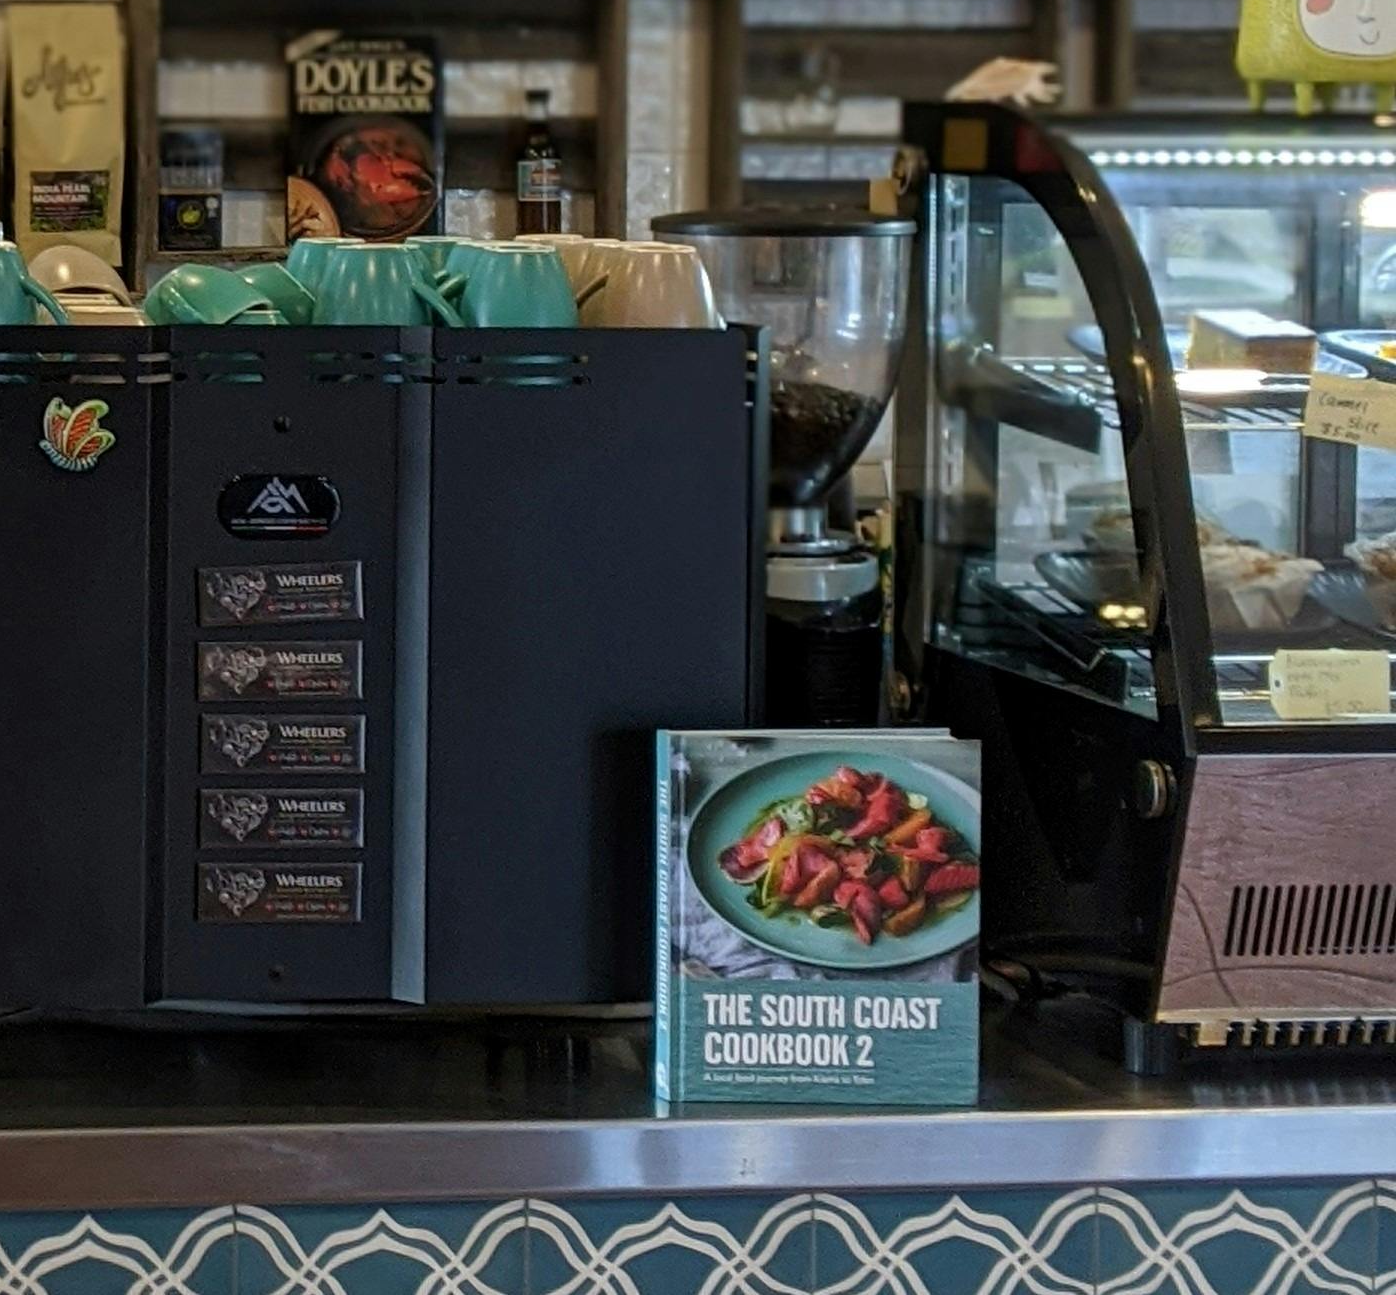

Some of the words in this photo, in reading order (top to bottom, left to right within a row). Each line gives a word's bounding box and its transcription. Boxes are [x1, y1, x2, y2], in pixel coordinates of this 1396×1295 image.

[275, 573, 344, 588] WHEELERS
[275, 651, 344, 665] WHEELERS
[278, 724, 347, 739] WHEELERS
[277, 799, 346, 813] WHEELERS
[275, 873, 344, 888] WHEELERS
[703, 993, 753, 1027] THE
[760, 994, 846, 1028] SOUTH
[854, 996, 942, 1030] COAST
[704, 1031, 850, 1067] COOKBOOK
[855, 1035, 875, 1067] 2
